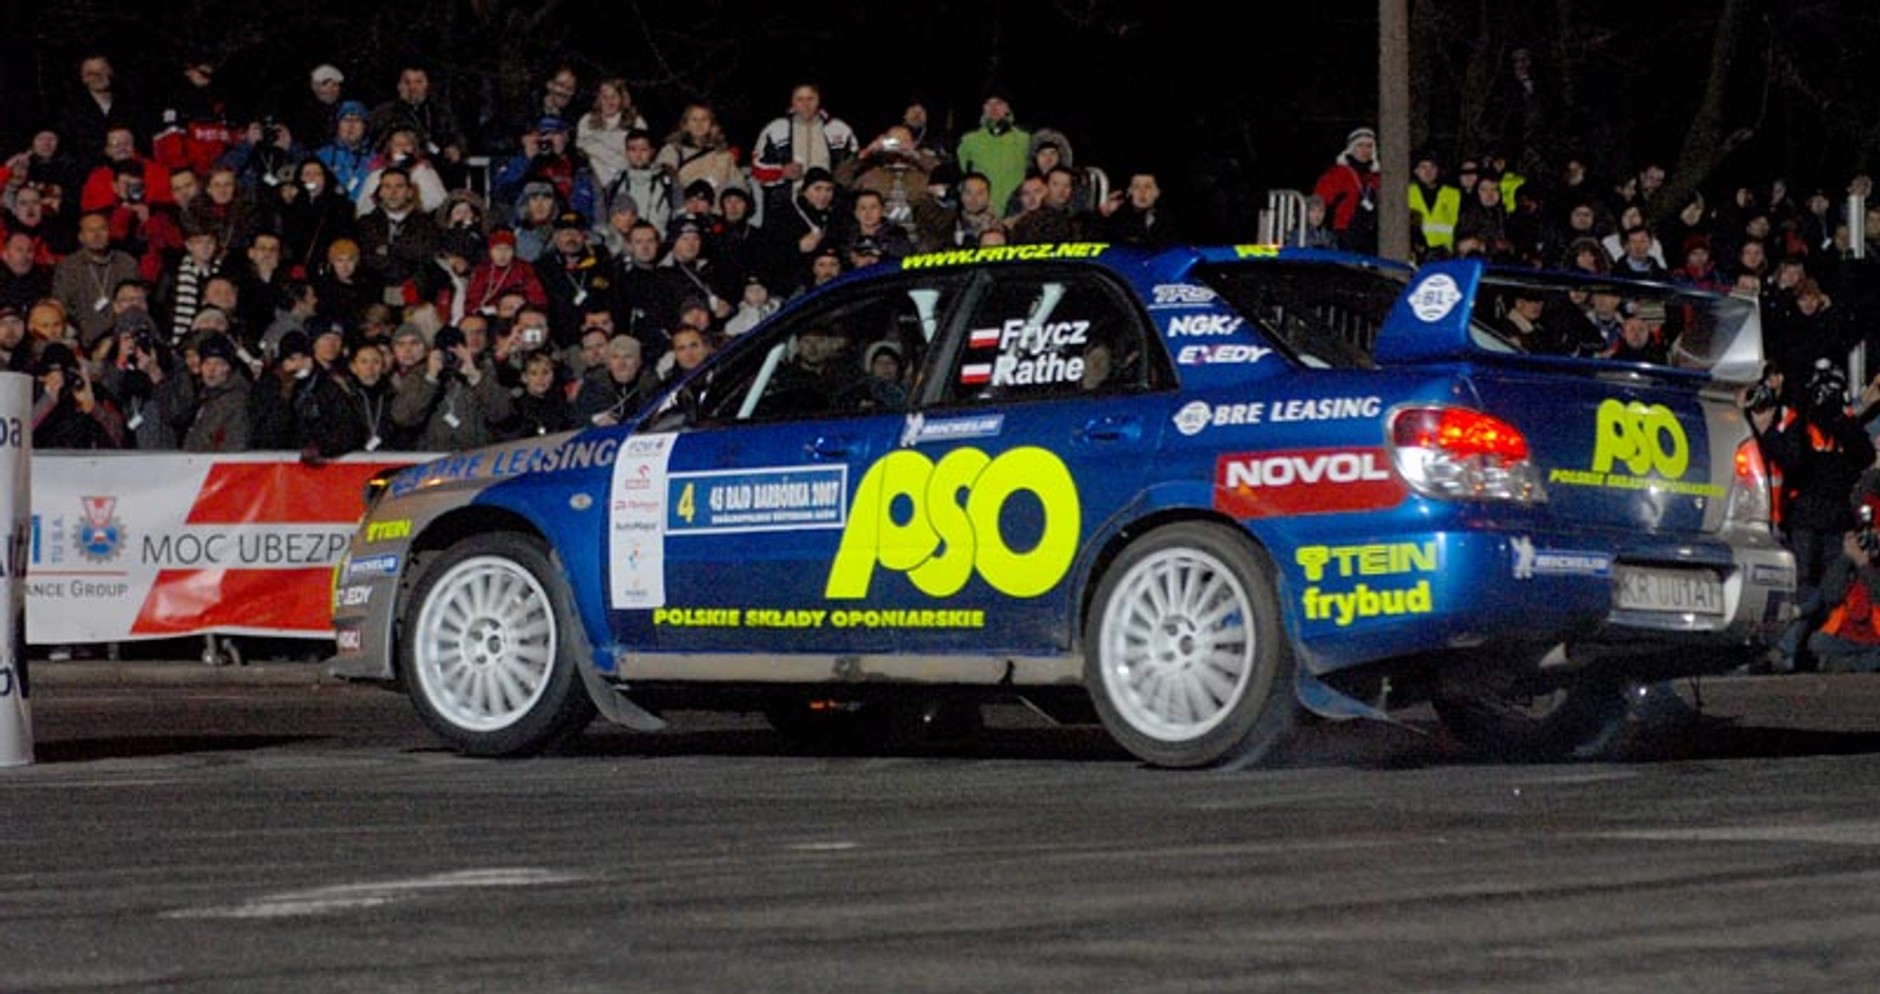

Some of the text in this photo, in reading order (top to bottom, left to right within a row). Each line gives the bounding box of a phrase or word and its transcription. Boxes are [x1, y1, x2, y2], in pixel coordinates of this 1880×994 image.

[902, 243, 1110, 270] WWW.FRYCZ.NET
[1000, 318, 1090, 358] Frycz
[1178, 345, 1272, 363] EXEDY
[991, 353, 1086, 387] Rathe
[1213, 397, 1381, 426] BRE LEASING
[492, 439, 617, 475] LEASING
[1226, 453, 1389, 488] NOVOL
[676, 483, 695, 523] 4
[142, 533, 226, 564] MOC
[1331, 542, 1436, 577] TEIN
[653, 609, 985, 627] POLSKIE SKŁADY OPONIARSKIE
[1303, 580, 1431, 626] frybud
